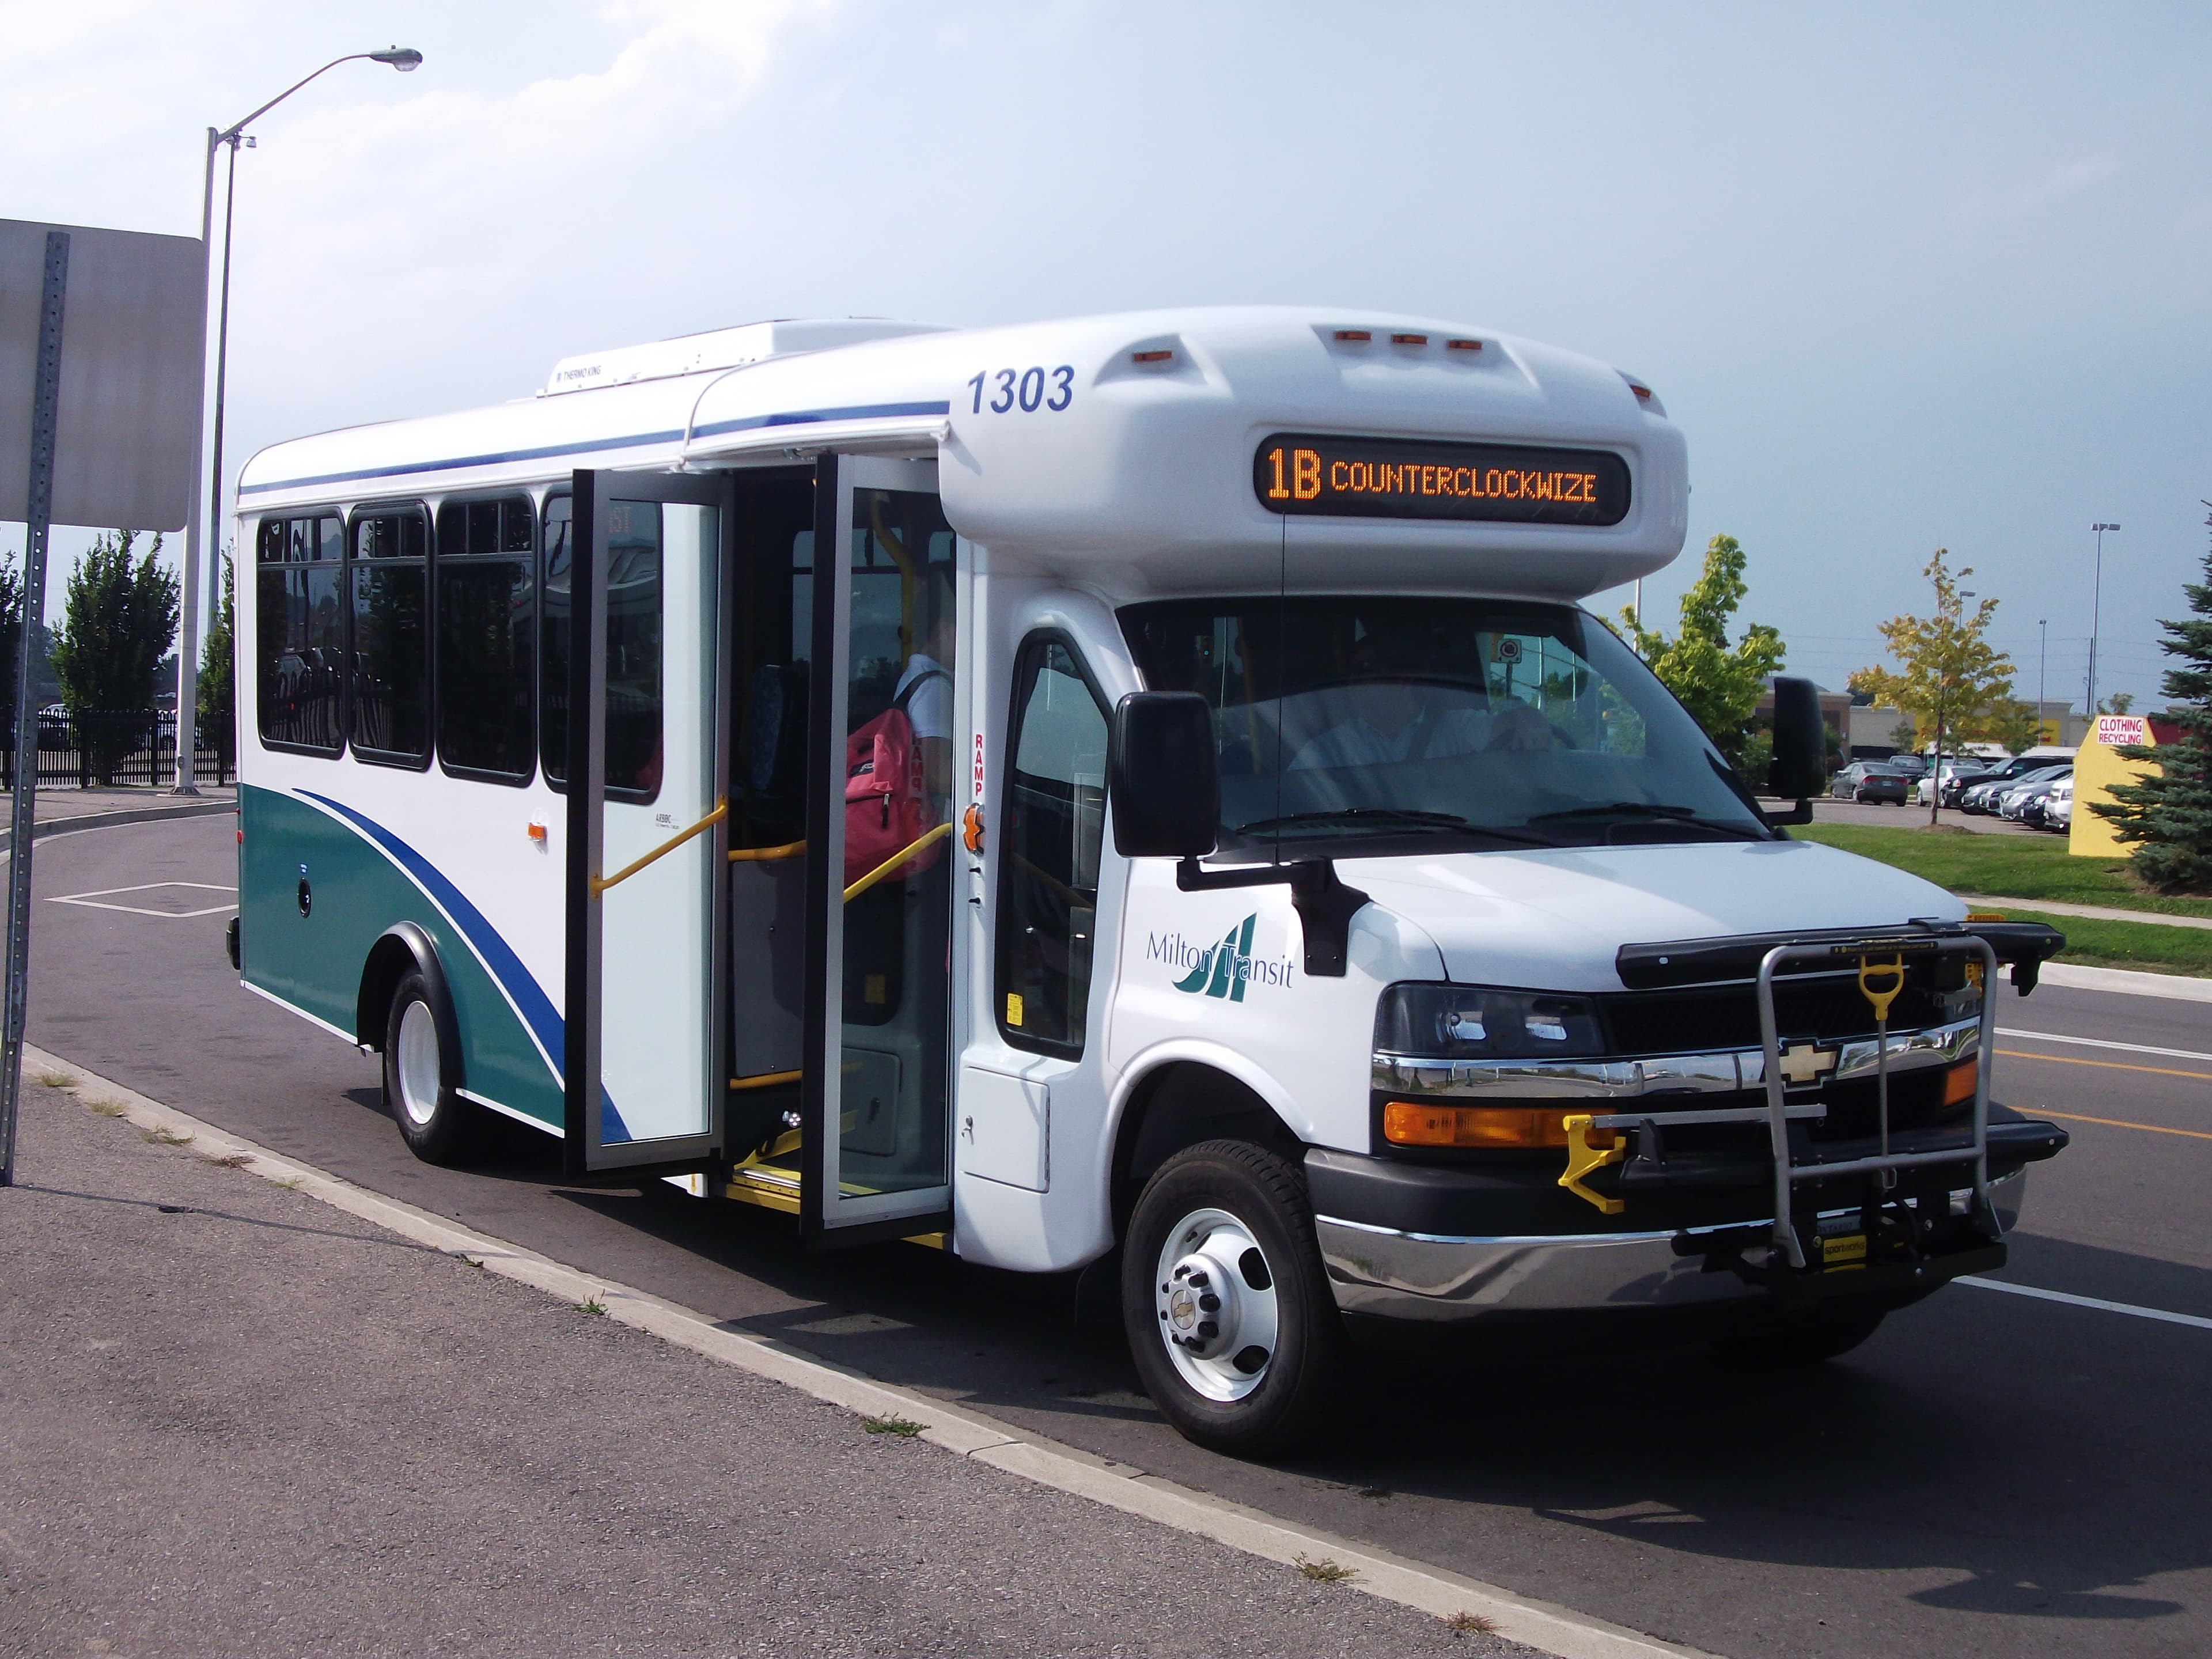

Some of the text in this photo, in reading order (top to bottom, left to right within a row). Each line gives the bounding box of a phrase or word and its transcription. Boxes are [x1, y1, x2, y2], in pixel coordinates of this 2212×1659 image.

[564, 365, 601, 380] THERMO KING
[968, 365, 1075, 414] 1303
[1268, 448, 1597, 502] 1B COUNTERCLOCKWIZE
[2099, 733, 2142, 744] RECYCLING
[2100, 718, 2142, 732] CLOTHING
[974, 734, 983, 796] RAMP
[1146, 931, 1294, 988] Milton Transit
